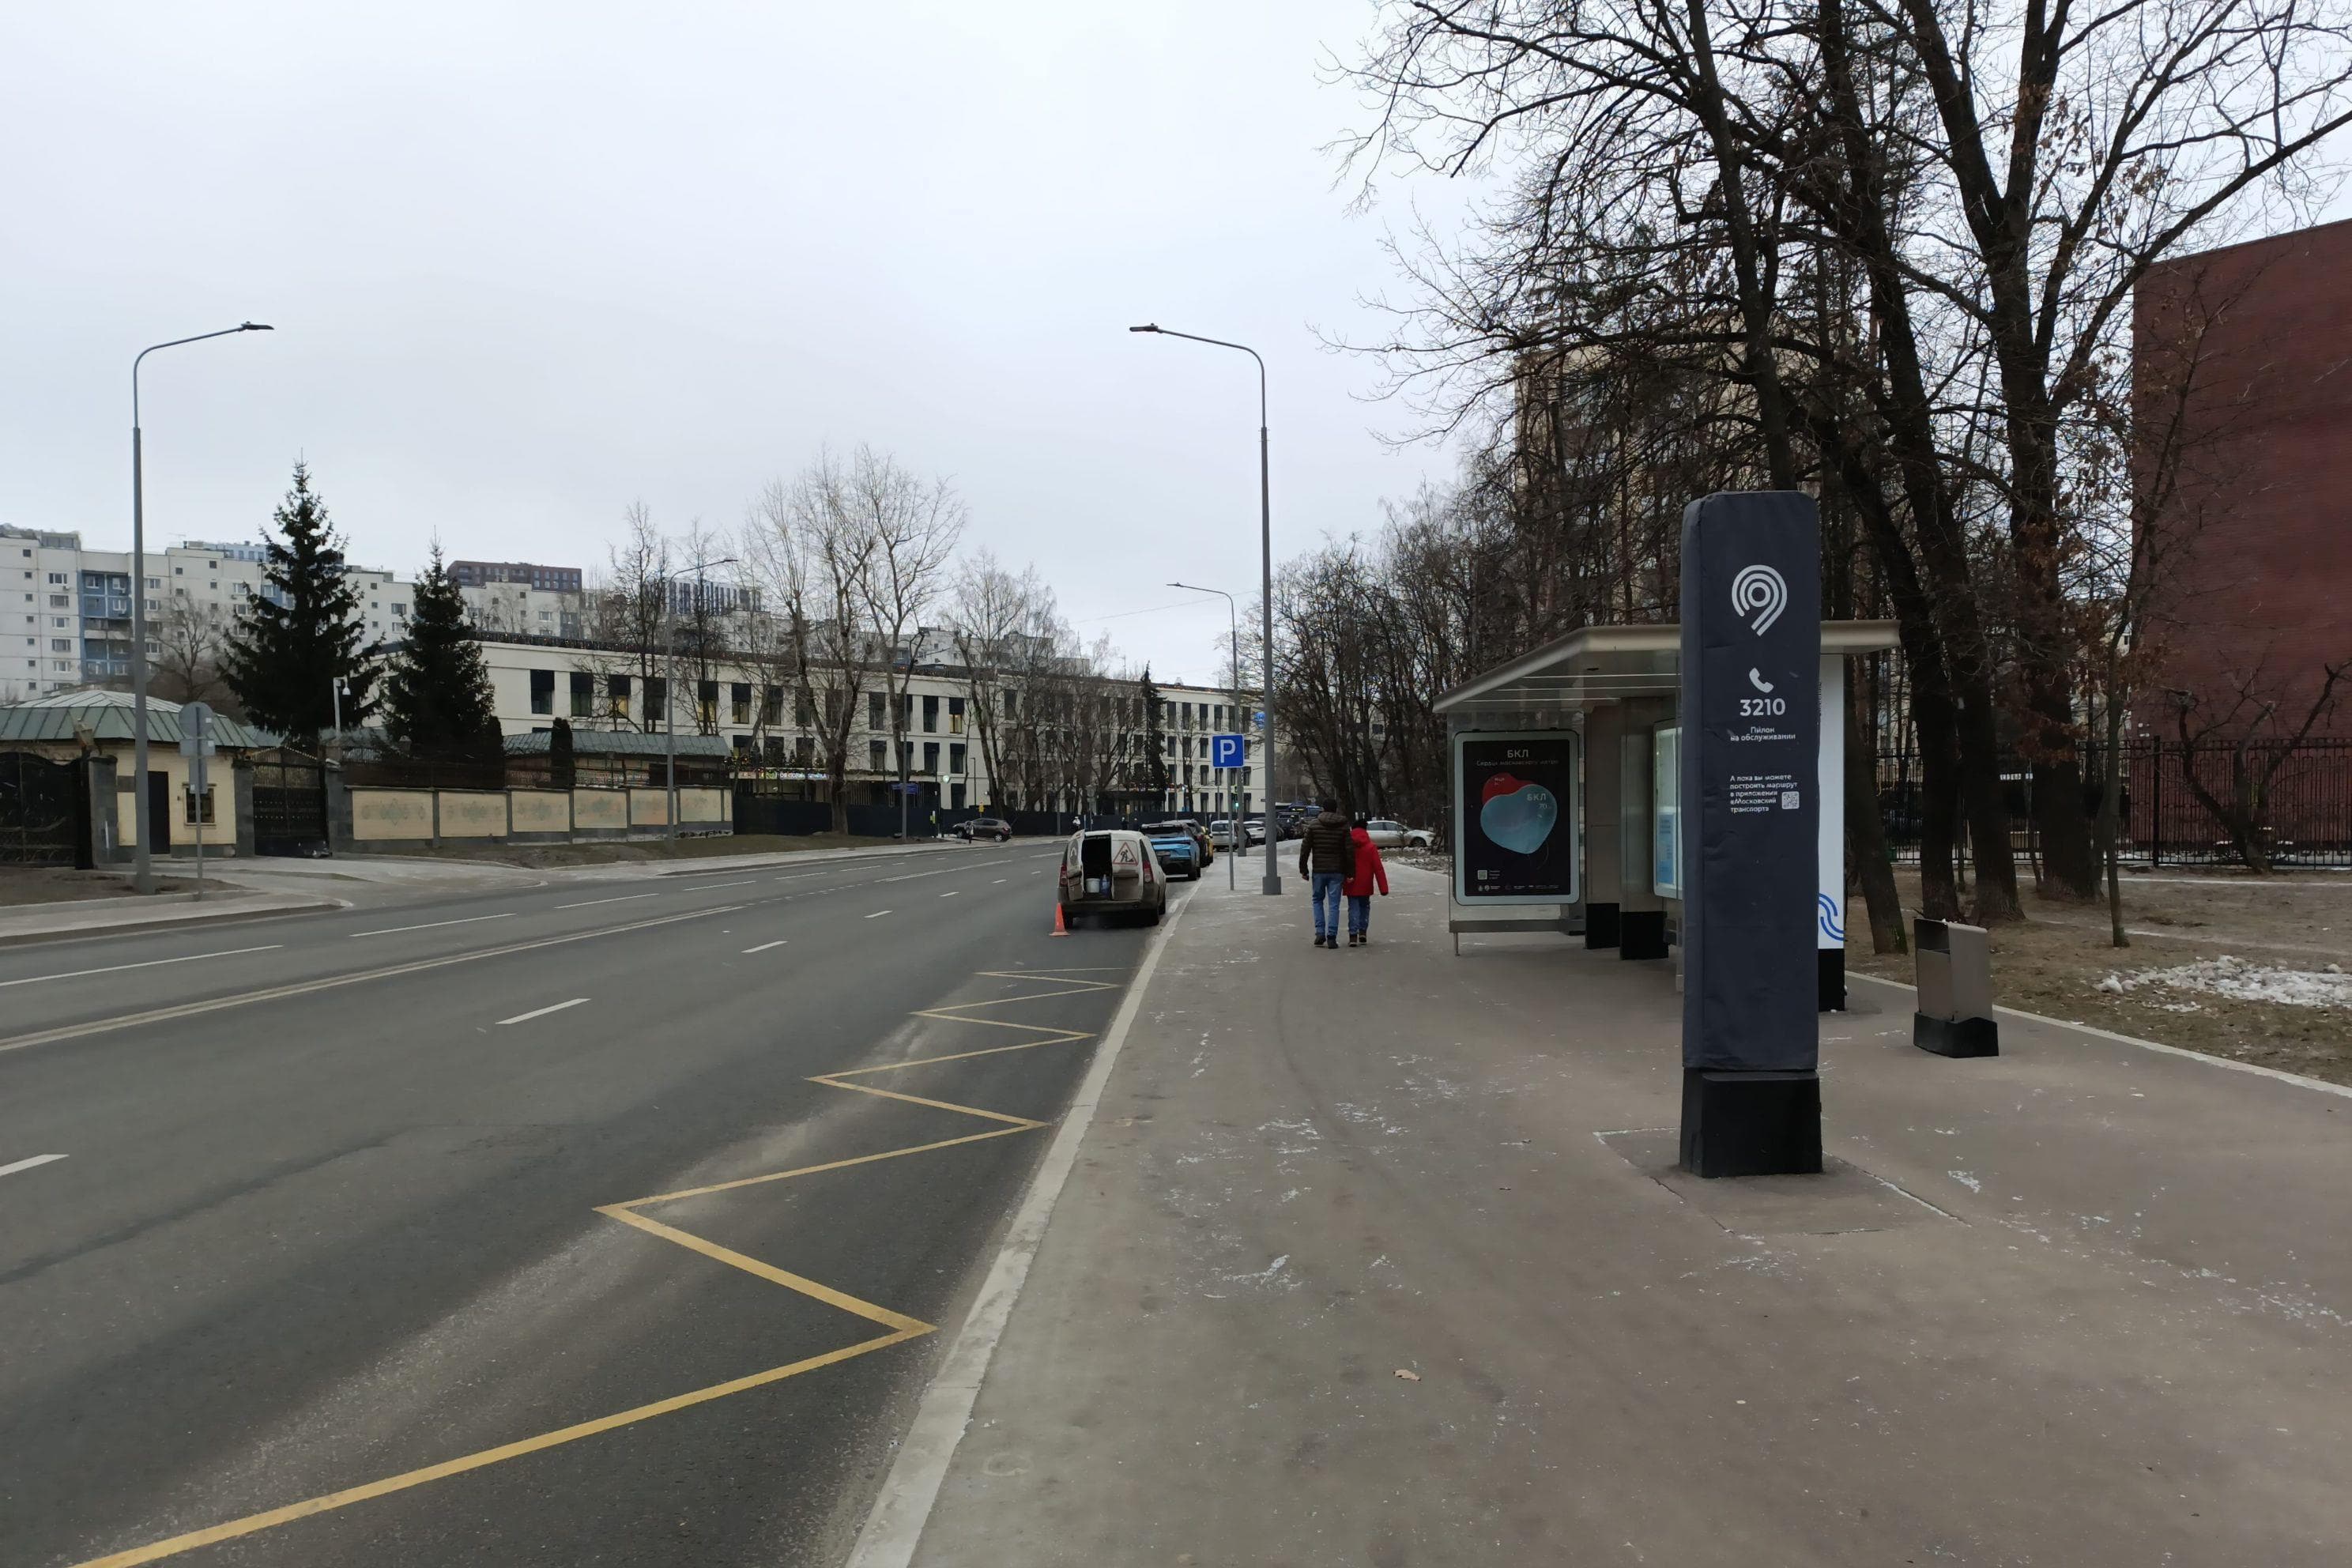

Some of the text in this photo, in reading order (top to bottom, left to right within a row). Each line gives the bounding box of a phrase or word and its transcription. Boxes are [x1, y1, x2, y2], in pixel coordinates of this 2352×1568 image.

[1740, 698, 1786, 716] 3210
[1741, 733, 1796, 742] обслуживании
[1220, 739, 1236, 763] P
[1506, 749, 1529, 758] БКЛ
[1526, 793, 1547, 801] БКЛ
